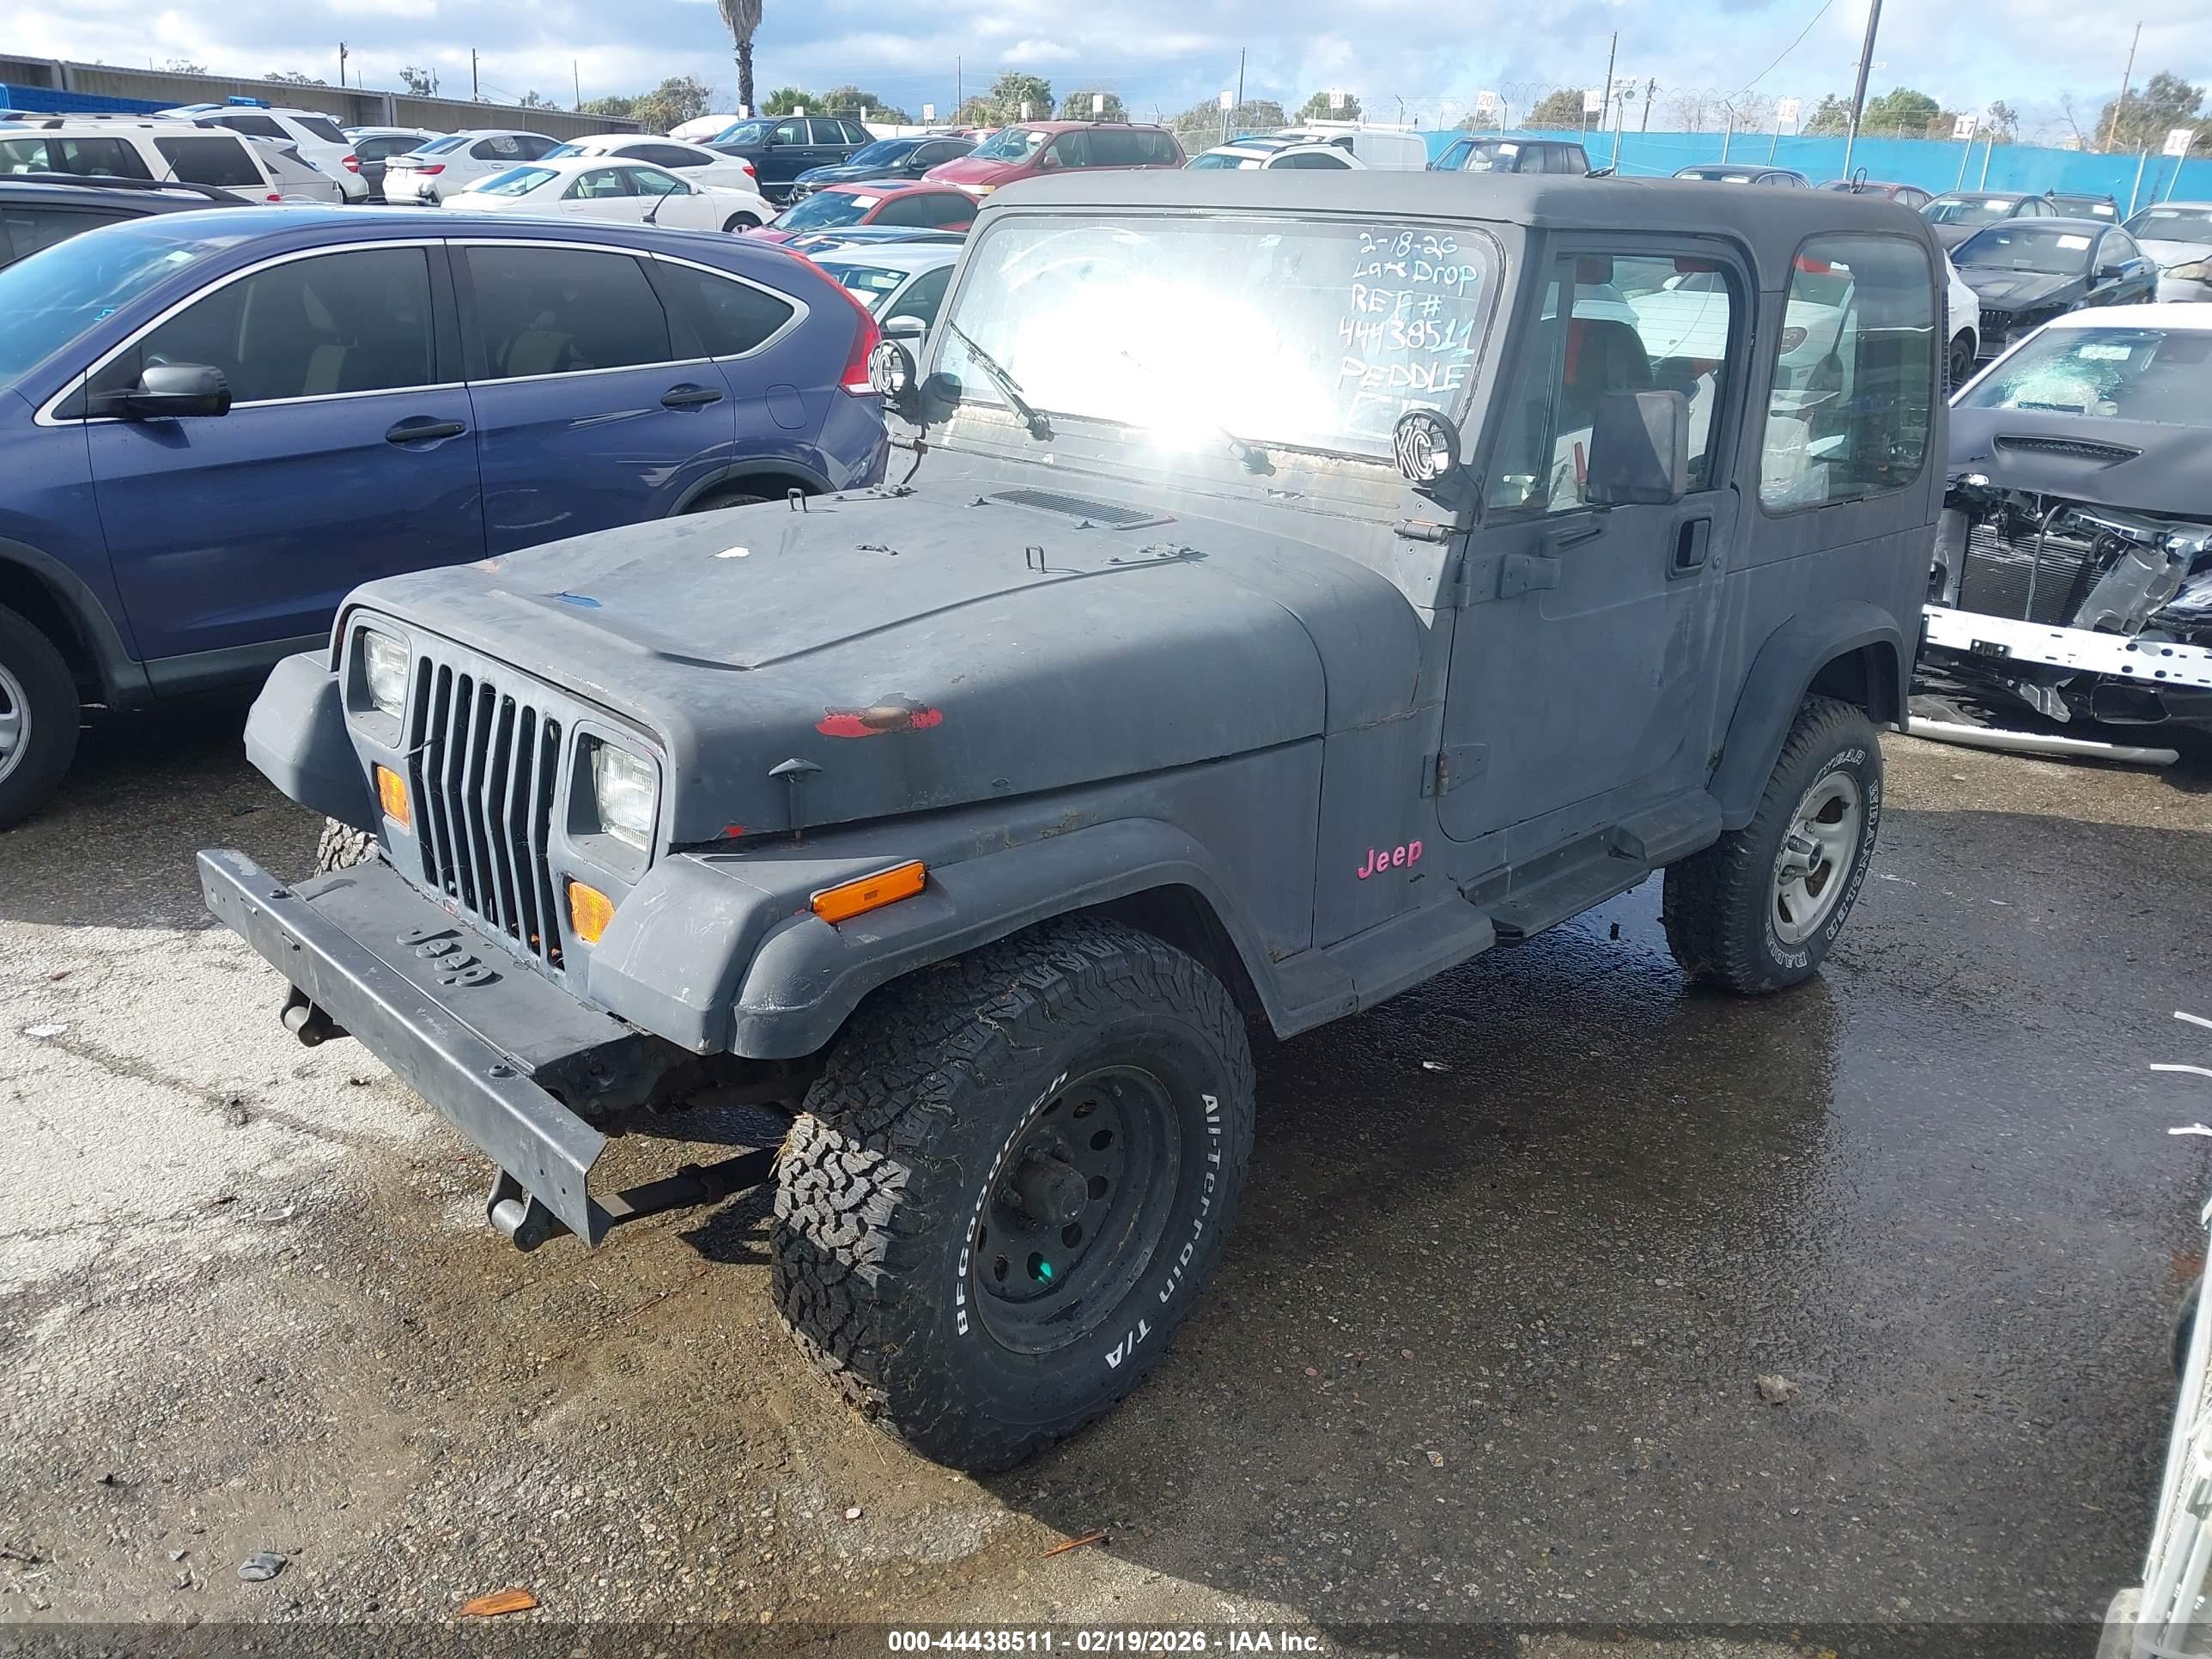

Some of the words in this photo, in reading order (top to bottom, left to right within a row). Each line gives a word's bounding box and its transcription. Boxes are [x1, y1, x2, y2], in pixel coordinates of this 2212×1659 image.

[1331, 94, 1343, 104] 21
[1479, 94, 1493, 106] 20
[1586, 94, 1598, 107] 19
[1779, 104, 1796, 117] 18
[1955, 120, 1975, 135] 17
[1413, 259, 1478, 297] Drop
[1338, 314, 1476, 358] 44438511
[867, 348, 892, 392] KC
[1337, 356, 1472, 394] PEDDLE
[1392, 425, 1435, 481] KC
[1357, 840, 1423, 880] Jeep
[1826, 779, 1879, 940] WRANGLER
[395, 929, 504, 988] Jeep
[1158, 1093, 1222, 1304] All-Terrain
[1104, 1318, 1152, 1370] T/A
